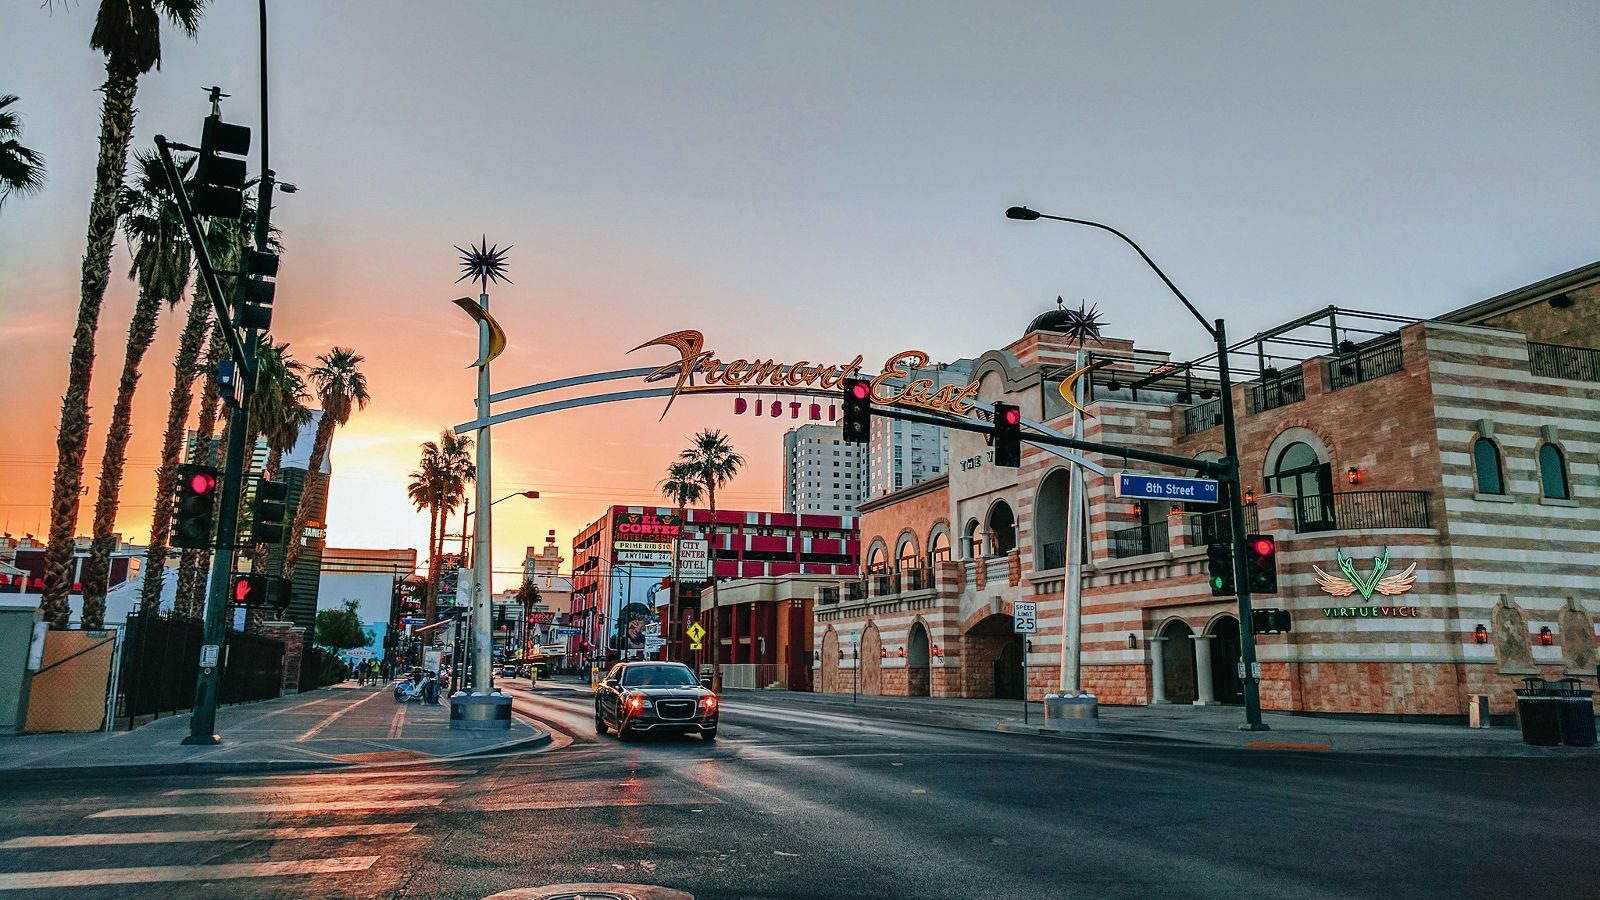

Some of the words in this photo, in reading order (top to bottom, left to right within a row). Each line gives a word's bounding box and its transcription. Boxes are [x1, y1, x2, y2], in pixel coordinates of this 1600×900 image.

[625, 329, 863, 422] Fremont
[869, 350, 980, 413] East
[734, 397, 845, 422] DISTRI
[960, 456, 981, 472] THE
[1123, 478, 1129, 486] N
[1145, 482, 1163, 494] 8th
[1165, 483, 1195, 496] Street
[642, 515, 660, 525] EL
[619, 523, 680, 535] CORTEZ
[620, 542, 643, 550] PRIME
[682, 541, 700, 550] CITY
[624, 552, 653, 560] ANYTIME
[680, 550, 706, 560] ENTER
[1016, 617, 1035, 630] 25
